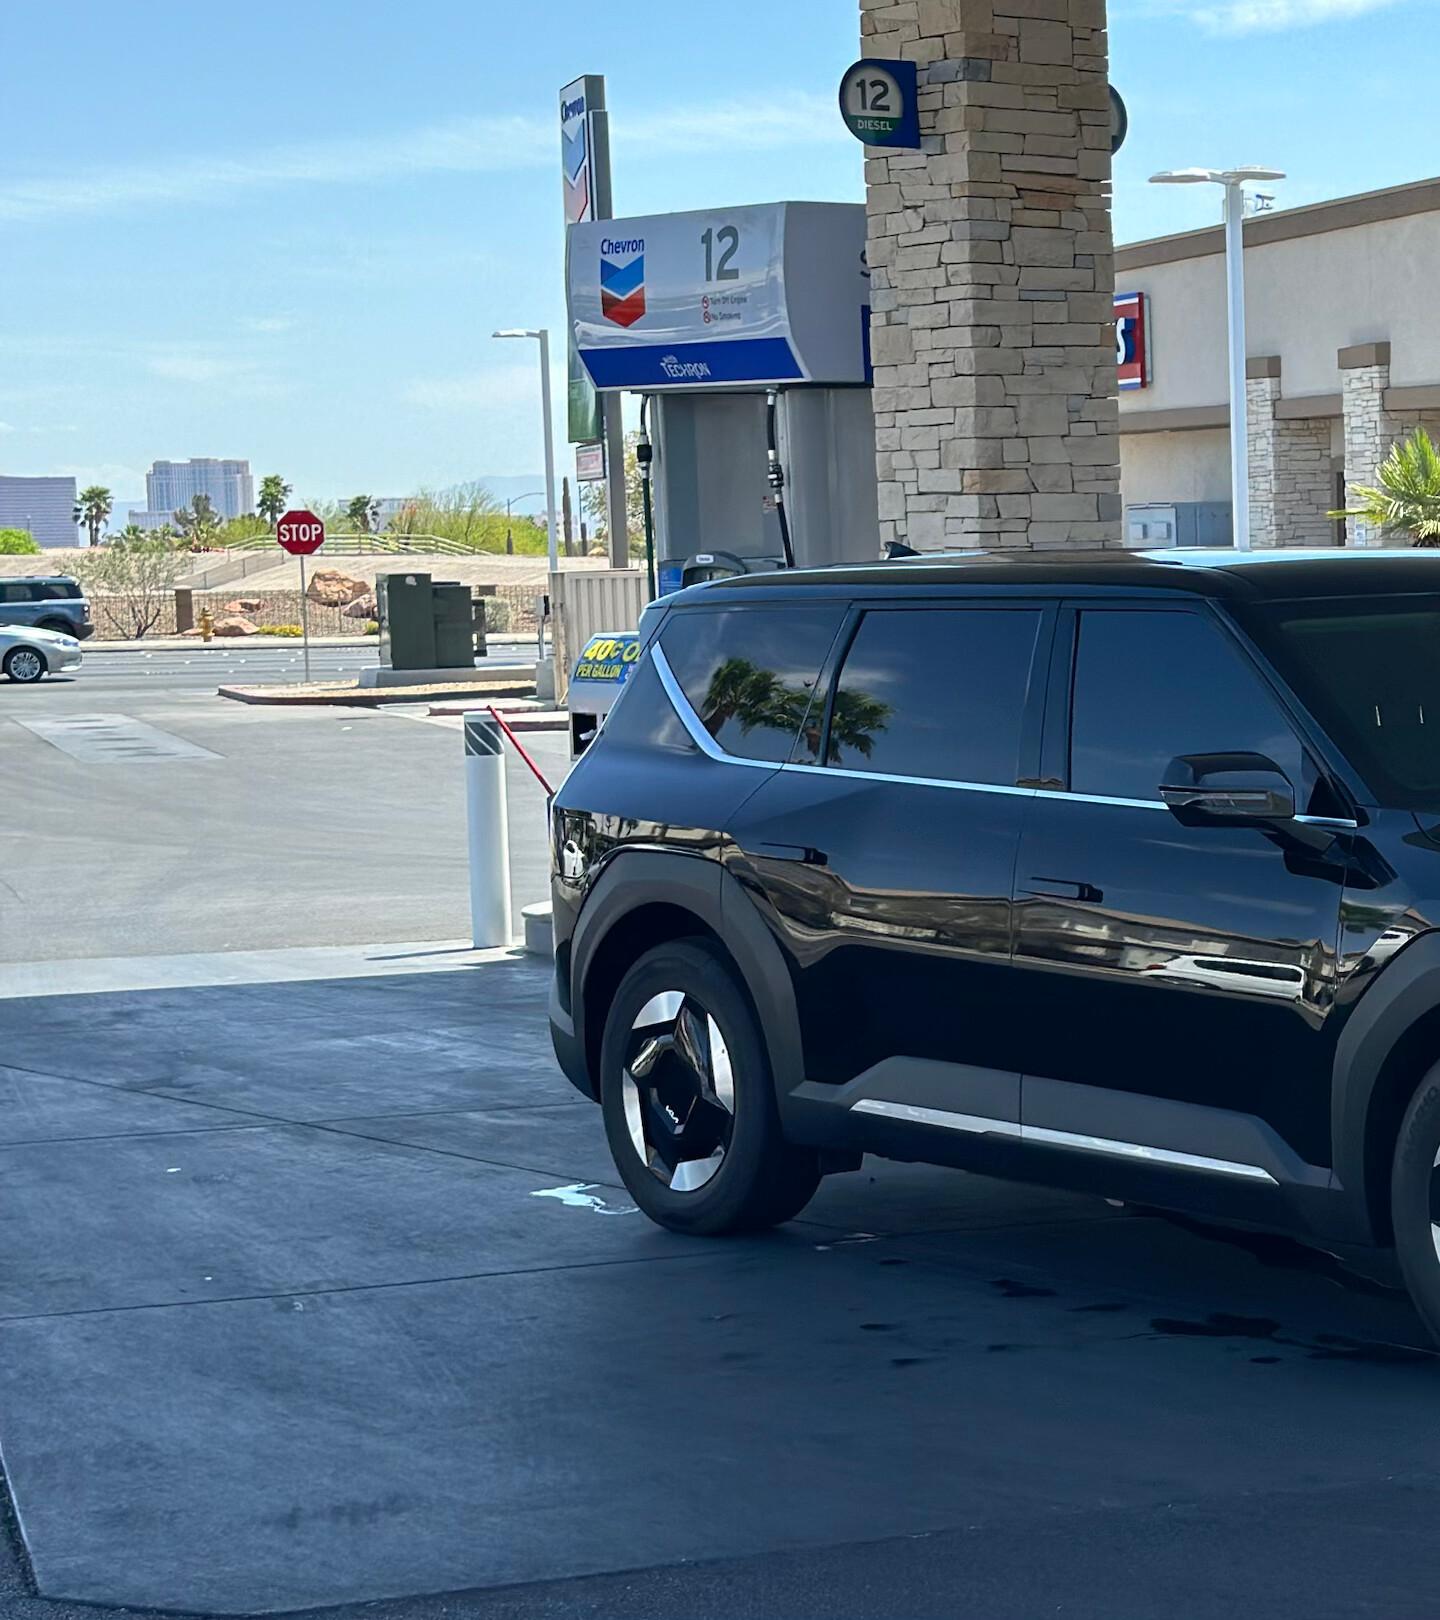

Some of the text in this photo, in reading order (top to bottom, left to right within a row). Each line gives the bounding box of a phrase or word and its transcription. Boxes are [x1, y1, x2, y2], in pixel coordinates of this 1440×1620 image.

[856, 79, 890, 111] 12
[857, 119, 893, 131] DIESEL
[600, 238, 645, 255] Chevron
[701, 225, 739, 281] 12
[280, 524, 322, 542] STOP
